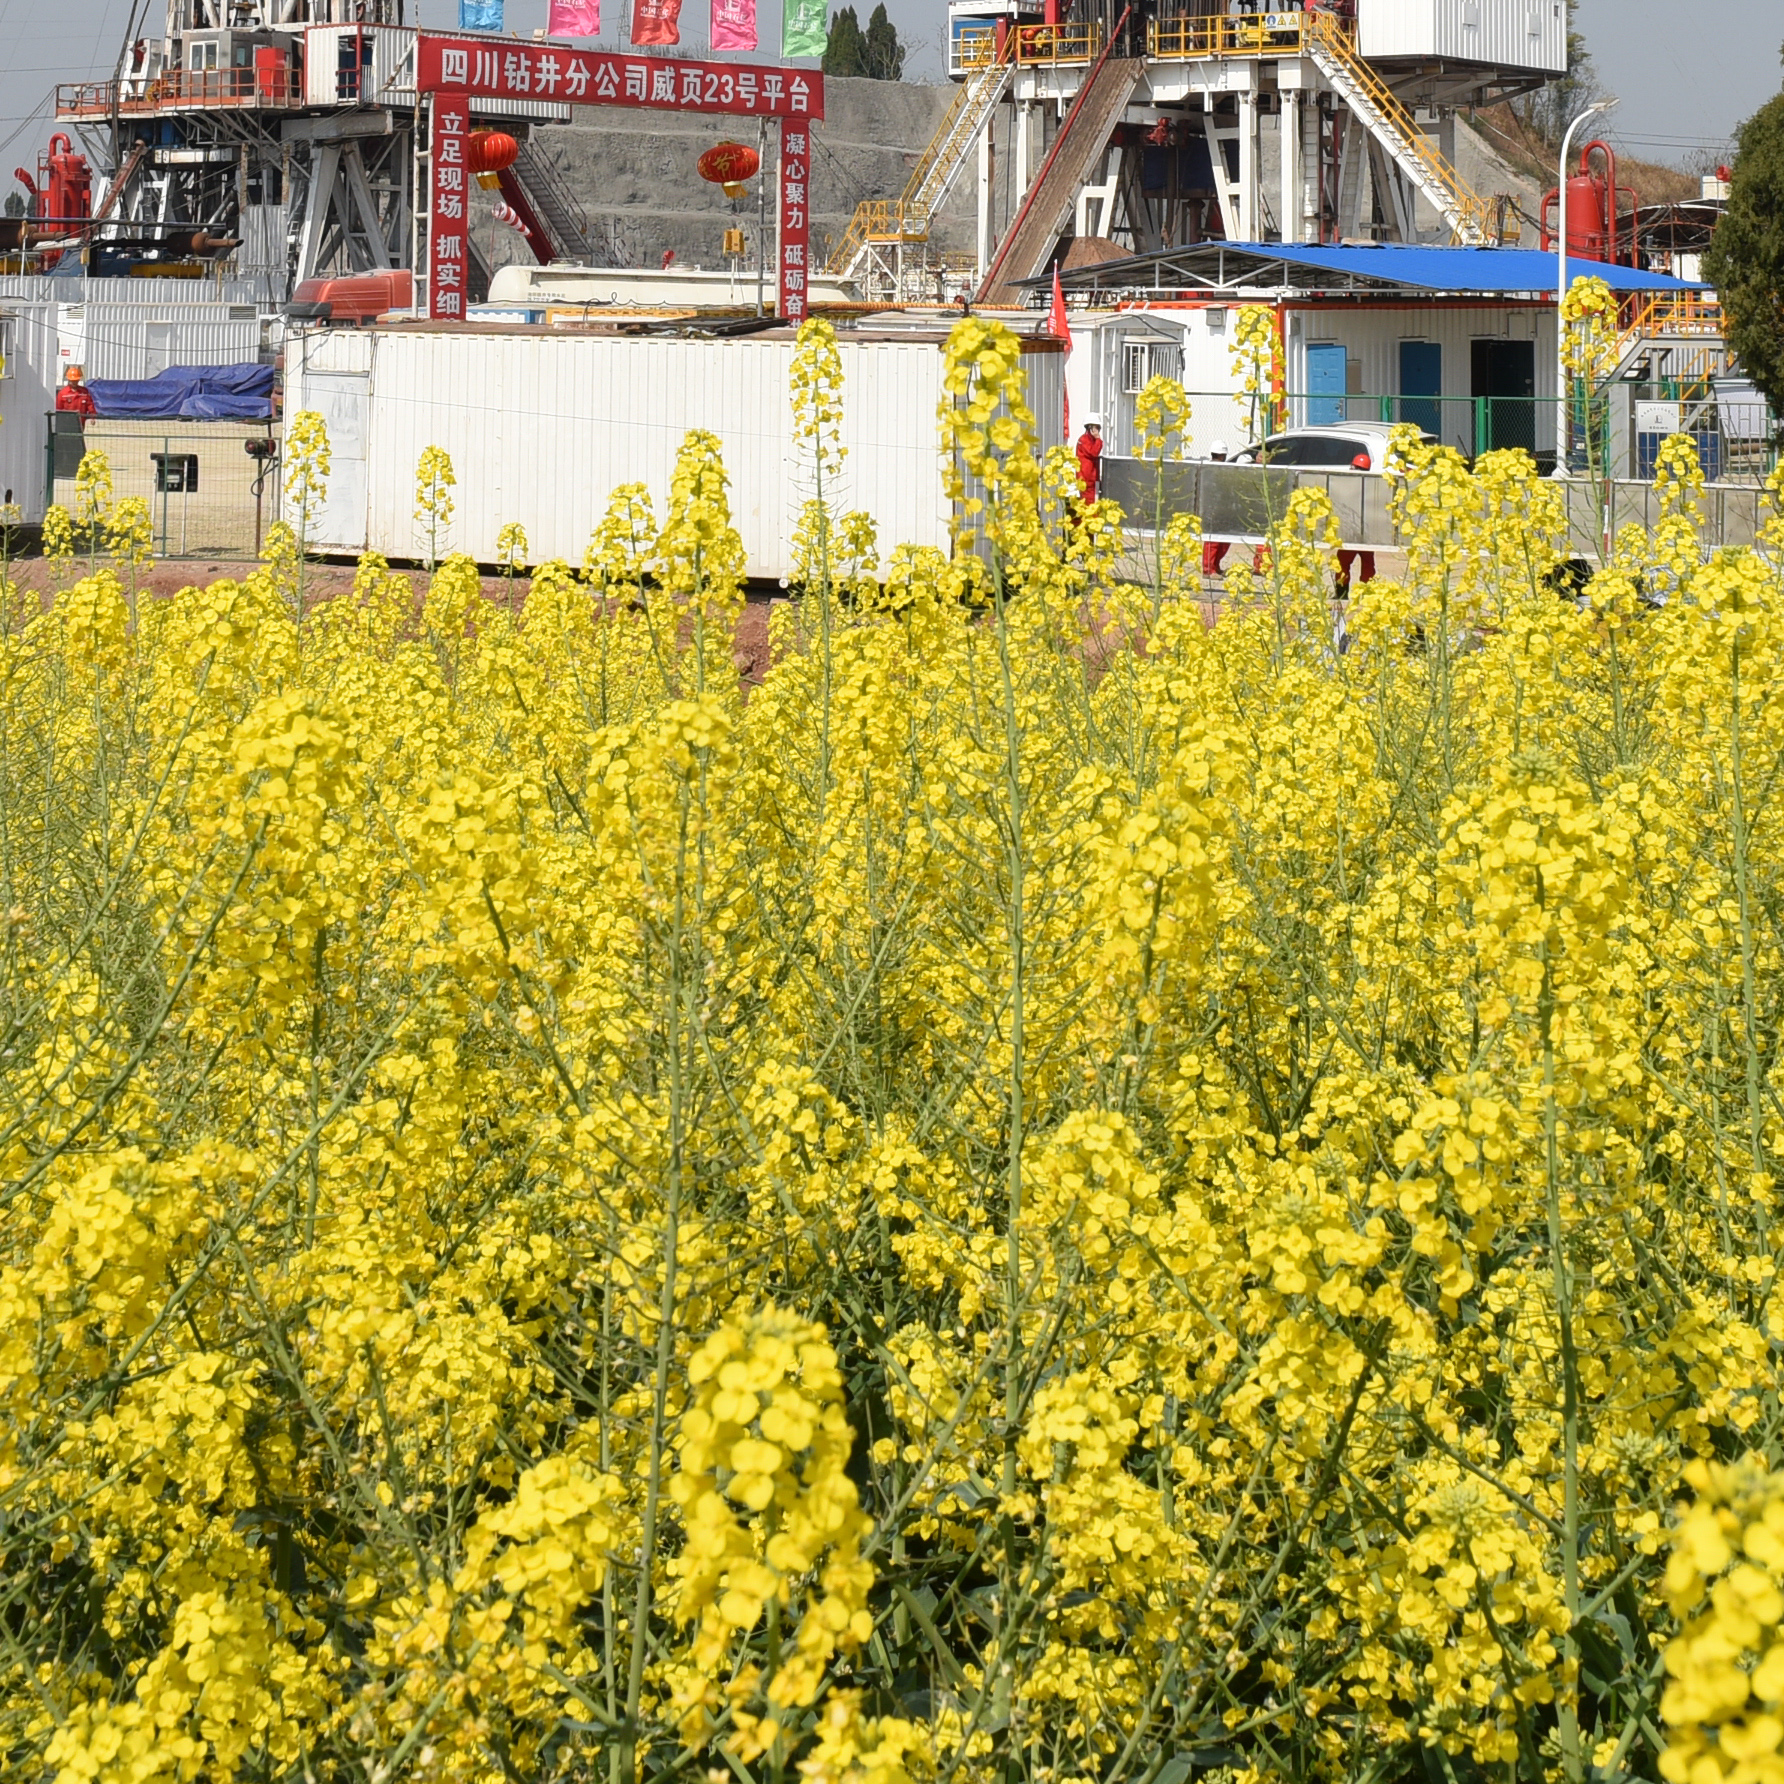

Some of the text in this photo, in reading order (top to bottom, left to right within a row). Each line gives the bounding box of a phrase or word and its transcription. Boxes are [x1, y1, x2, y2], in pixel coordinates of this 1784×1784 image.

[441, 48, 810, 112] 四川钻井分公司威页23号平台
[435, 111, 464, 321] 立足现场 抓实细
[785, 132, 806, 229] 凝心聚力
